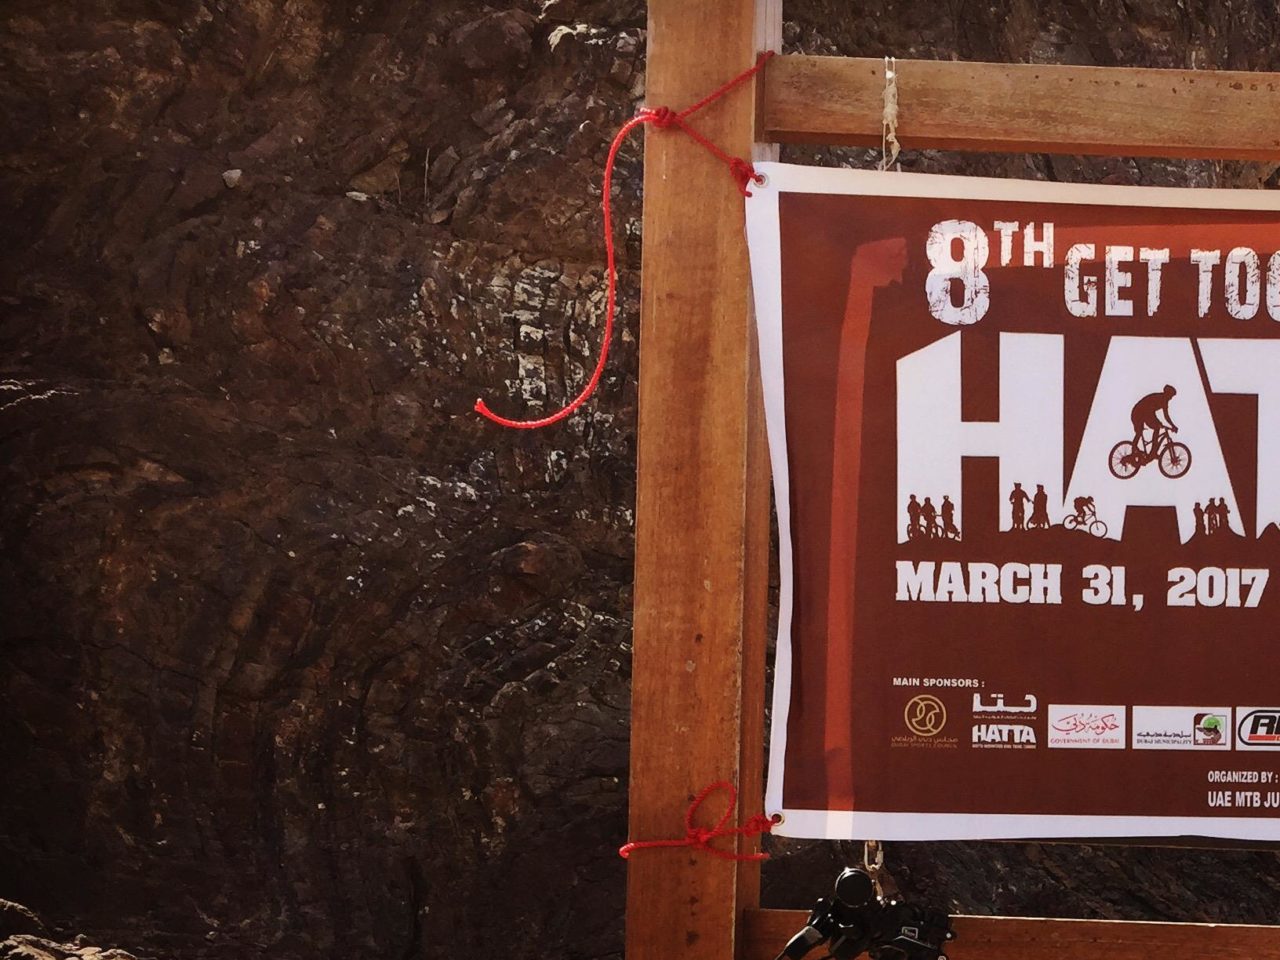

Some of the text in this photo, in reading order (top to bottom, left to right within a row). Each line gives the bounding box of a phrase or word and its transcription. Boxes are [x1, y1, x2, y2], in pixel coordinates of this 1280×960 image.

[925, 218, 1055, 324] 8TH
[1064, 242, 1170, 317] GET
[895, 560, 1270, 612] MARCH 31, 2017
[892, 677, 920, 686] MAIN
[922, 678, 979, 688] SPONSORS
[972, 724, 1037, 744] HATTA
[1207, 770, 1259, 783] ORGANIZED
[1260, 771, 1273, 784] BY
[1207, 790, 1232, 807] UAE
[1235, 791, 1261, 808] MTB
